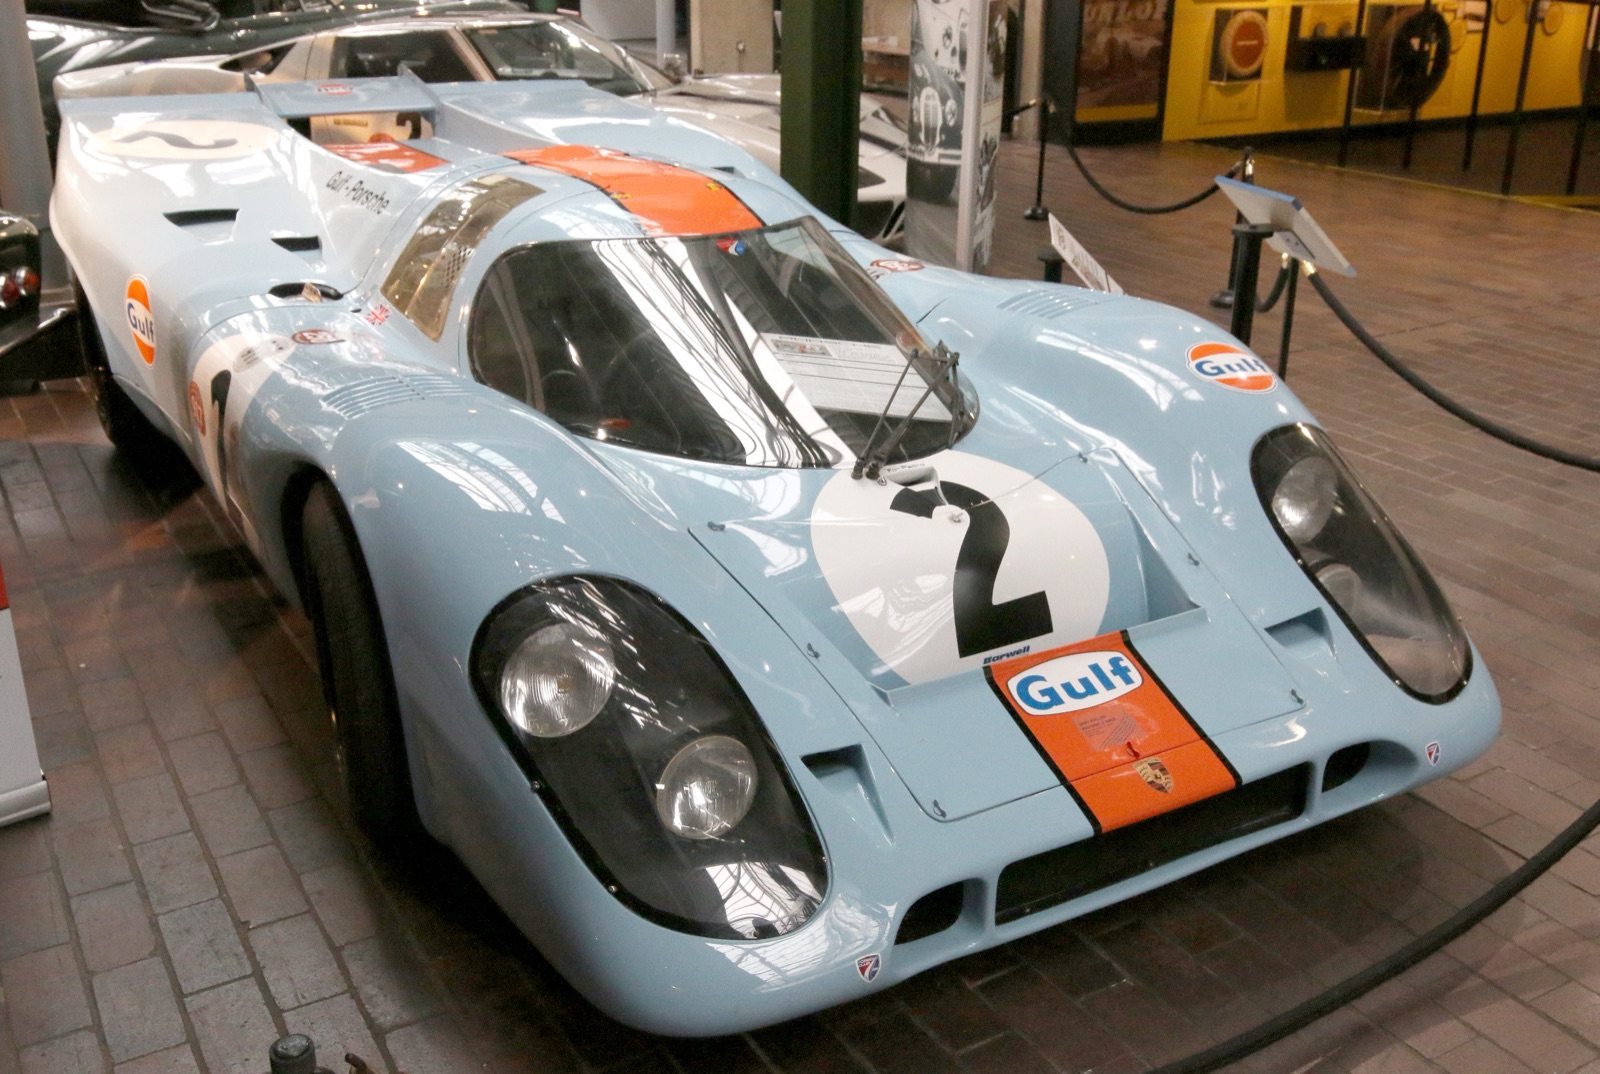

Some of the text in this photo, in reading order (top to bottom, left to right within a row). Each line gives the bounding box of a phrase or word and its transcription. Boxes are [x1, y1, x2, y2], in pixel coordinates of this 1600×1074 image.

[325, 170, 353, 193] Gulf
[345, 179, 391, 215] Porsche
[126, 301, 154, 344] Gulf
[1194, 357, 1270, 377] Gulf
[889, 480, 1054, 659] 2
[982, 644, 1032, 665] Barwell
[1015, 655, 1136, 711] Gulf
